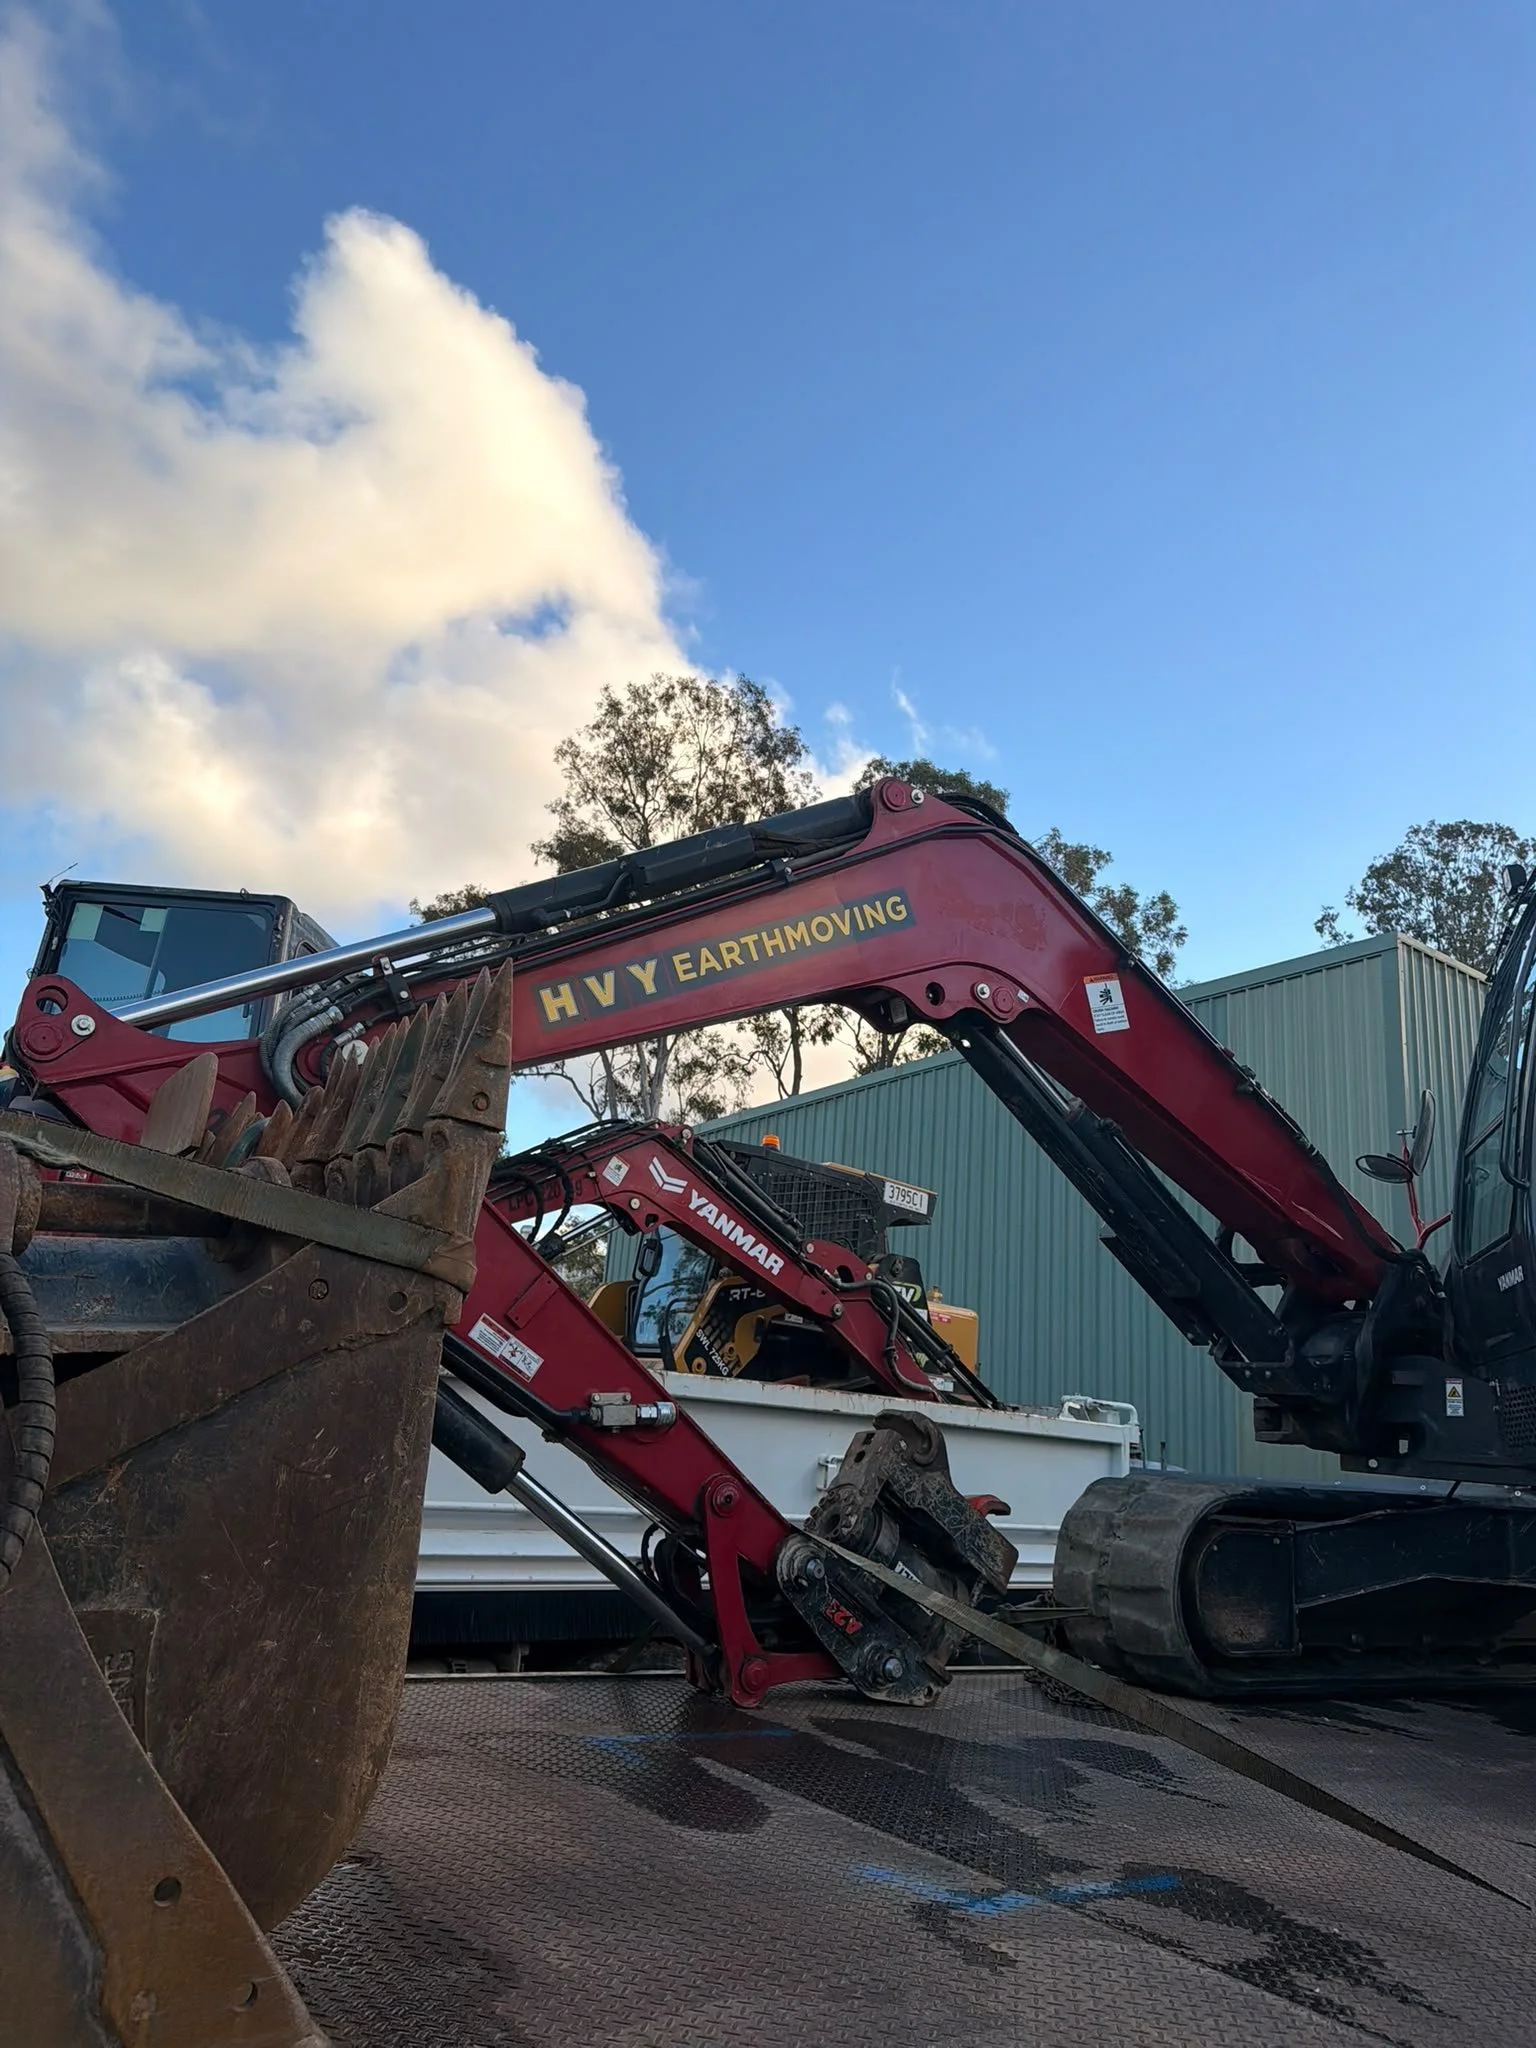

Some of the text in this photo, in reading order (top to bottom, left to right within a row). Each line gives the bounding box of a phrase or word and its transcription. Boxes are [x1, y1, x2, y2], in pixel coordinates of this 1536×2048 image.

[671, 895, 908, 983] EARTHMOVING
[688, 1189, 784, 1275] YANMAR
[1497, 1265, 1524, 1291] YANMAR
[695, 1328, 730, 1377] SWL 725KG
